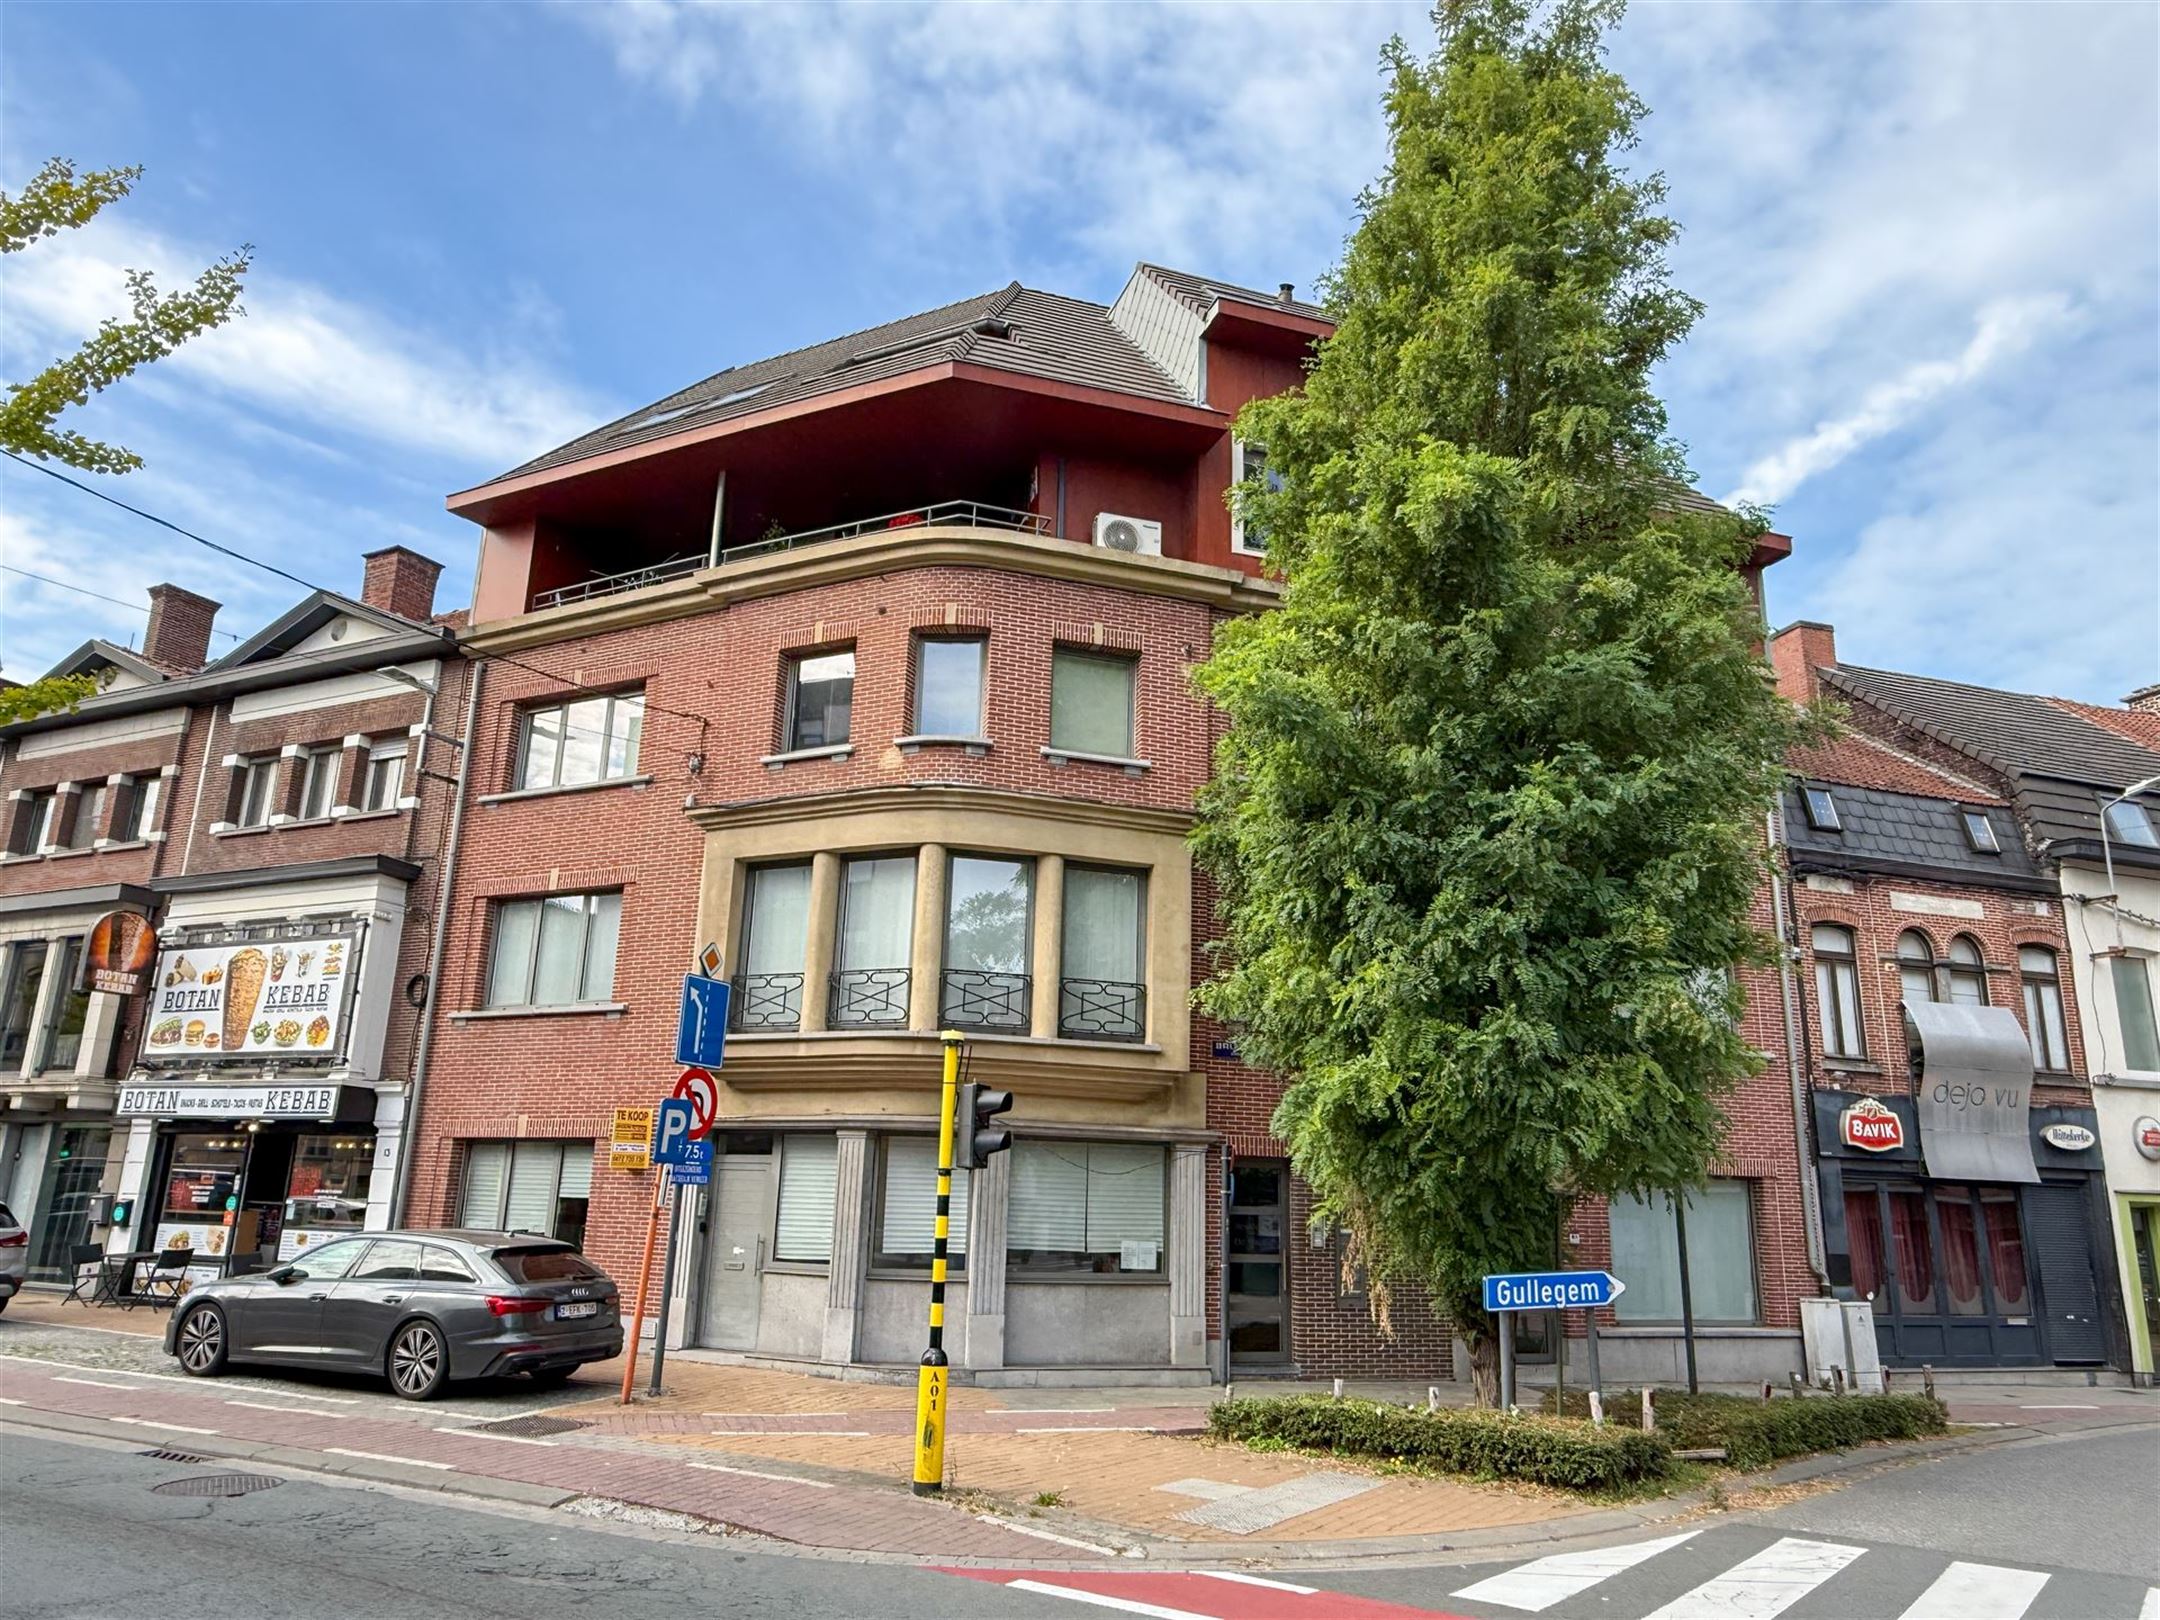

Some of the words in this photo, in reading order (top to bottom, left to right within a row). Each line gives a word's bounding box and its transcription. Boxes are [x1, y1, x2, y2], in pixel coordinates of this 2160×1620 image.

[95, 968, 139, 985] BOTAN
[95, 980, 134, 994] KEBAB
[163, 988, 221, 1010] BOTAN
[266, 983, 331, 1005] KEBAB
[122, 1090, 181, 1111] BOTAN
[265, 1090, 332, 1111] KEBAB
[1995, 1087, 2019, 1108] vu
[616, 1109, 627, 1121] TE
[627, 1109, 649, 1122] KOOP
[660, 1108, 687, 1154] P
[1851, 1119, 1897, 1139] BAVIK
[1496, 1279, 1600, 1309] Gullegem
